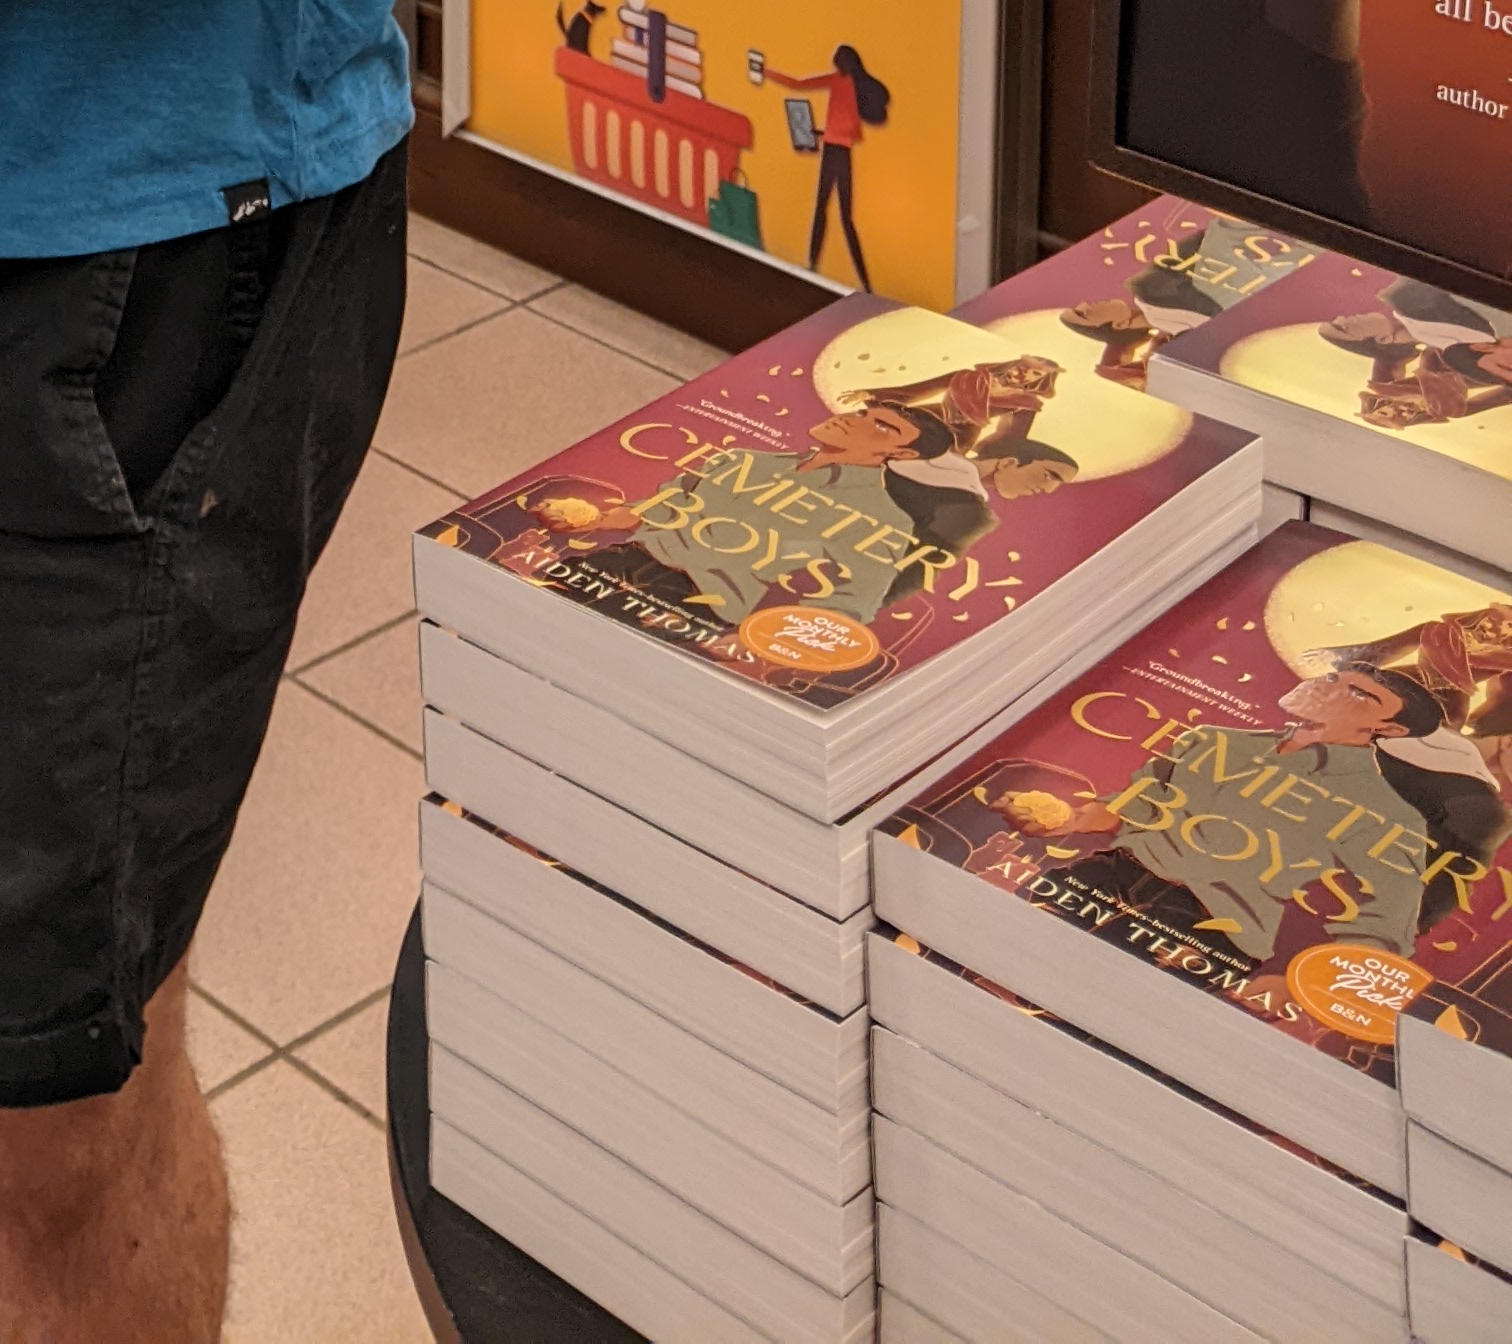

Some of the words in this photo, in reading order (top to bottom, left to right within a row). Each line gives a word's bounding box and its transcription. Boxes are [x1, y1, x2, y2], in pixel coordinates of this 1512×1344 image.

[1436, 81, 1508, 120] author
[619, 422, 1014, 602] CEMETERY
[630, 486, 853, 600] BOYS
[512, 549, 613, 600] AIDEN
[622, 596, 758, 666] THOMAS
[814, 616, 850, 634] OUR
[782, 614, 863, 647] MONTHLY
[1105, 776, 1373, 924] BOYS
[986, 860, 1117, 928] AIDEN
[1126, 923, 1304, 1023] THOMAS
[1064, 875, 1089, 891] New
[1089, 887, 1118, 905] York
[1212, 949, 1251, 974] author
[1329, 955, 1415, 1000] MONTHL
[1329, 973, 1404, 1011] Pick
[1363, 957, 1411, 983] OUR
[1329, 1002, 1372, 1027] B&N
